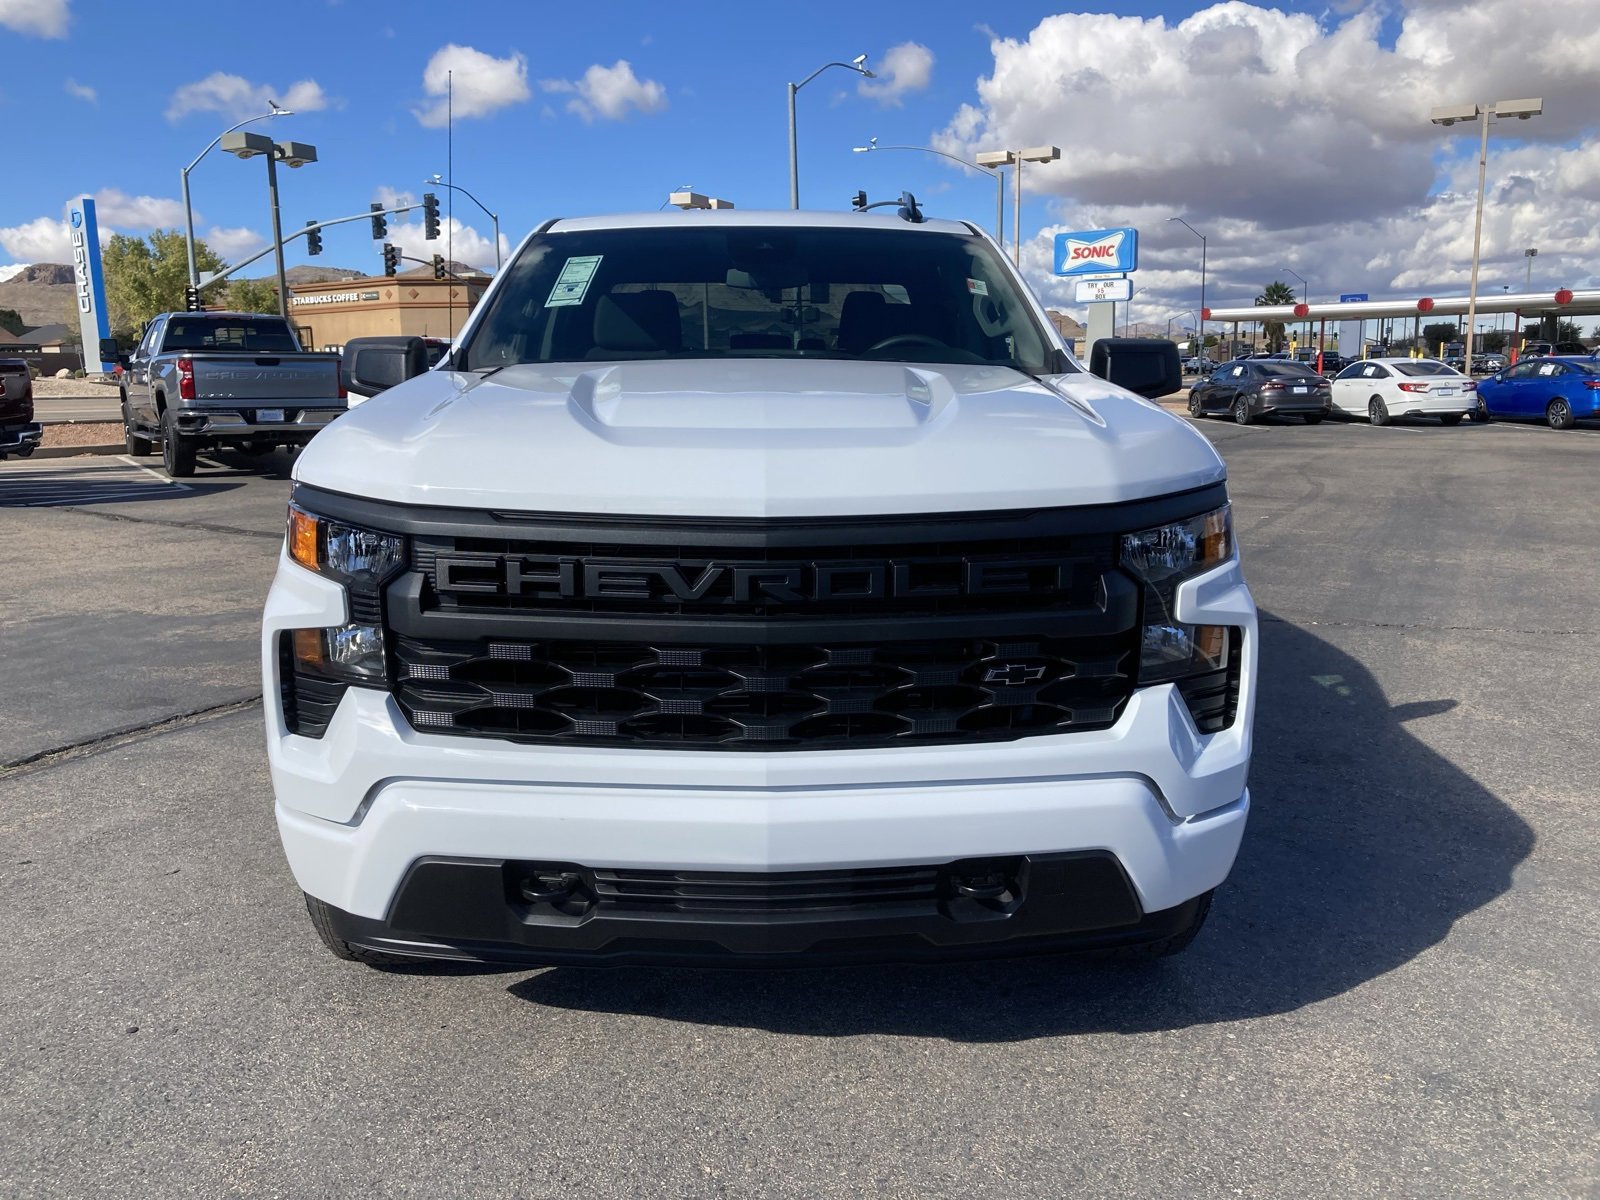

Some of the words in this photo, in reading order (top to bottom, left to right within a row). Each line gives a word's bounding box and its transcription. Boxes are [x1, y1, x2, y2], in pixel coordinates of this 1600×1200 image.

[1071, 244, 1116, 260] SONIC
[72, 231, 91, 313] CHASE
[292, 295, 332, 305] STARBUCKS
[332, 292, 359, 302] COFFEE
[434, 551, 1076, 602] CHEVROLET
